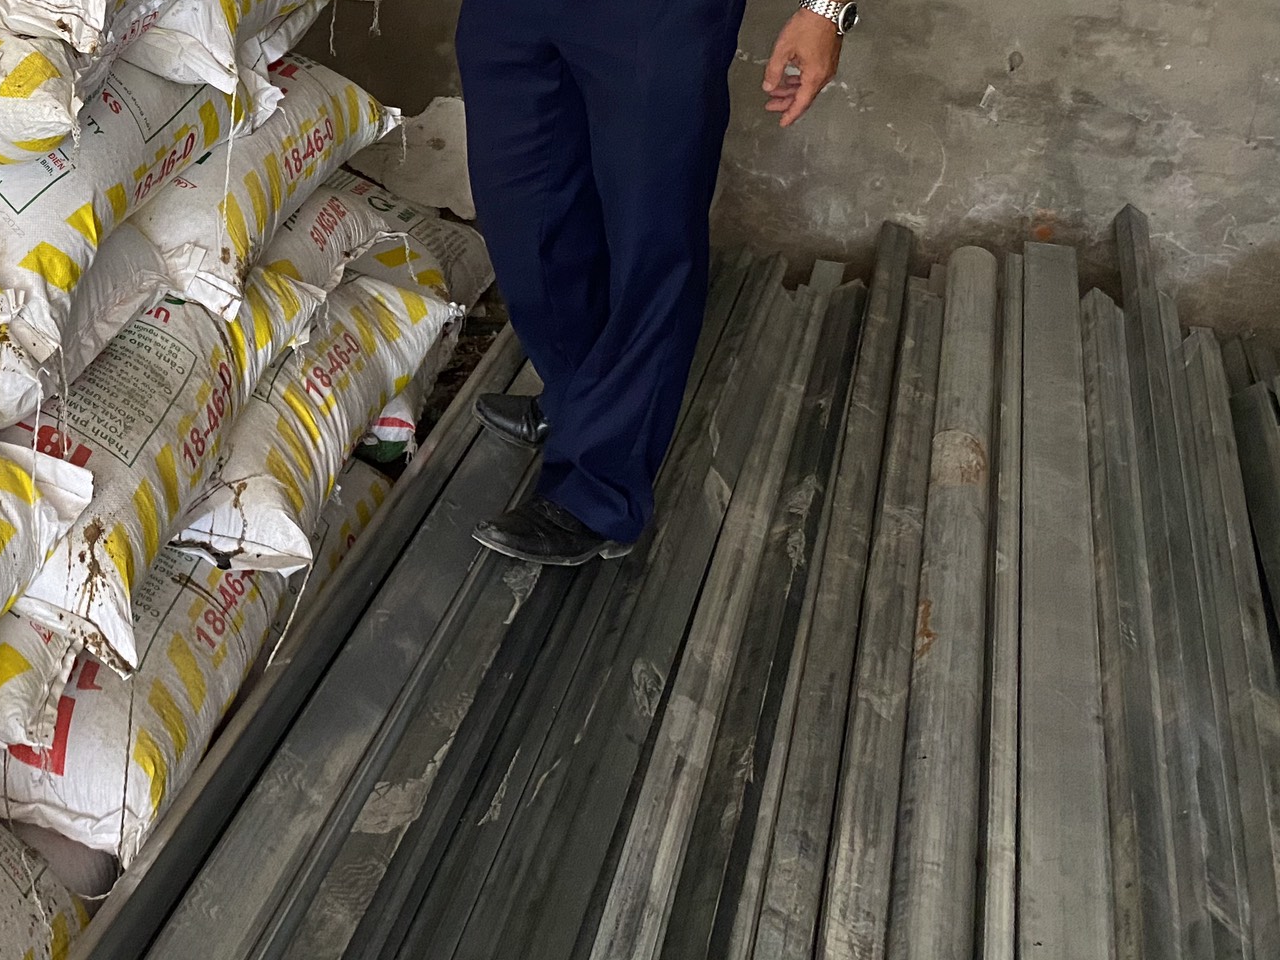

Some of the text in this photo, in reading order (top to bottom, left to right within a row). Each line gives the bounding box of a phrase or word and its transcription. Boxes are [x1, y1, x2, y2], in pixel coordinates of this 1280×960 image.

[285, 118, 334, 180] 18-46-0
[306, 332, 361, 398] 18-46-0
[88, 410, 128, 439] TOTAL
[92, 427, 128, 458] Thành
[182, 360, 234, 469] 18-46-0
